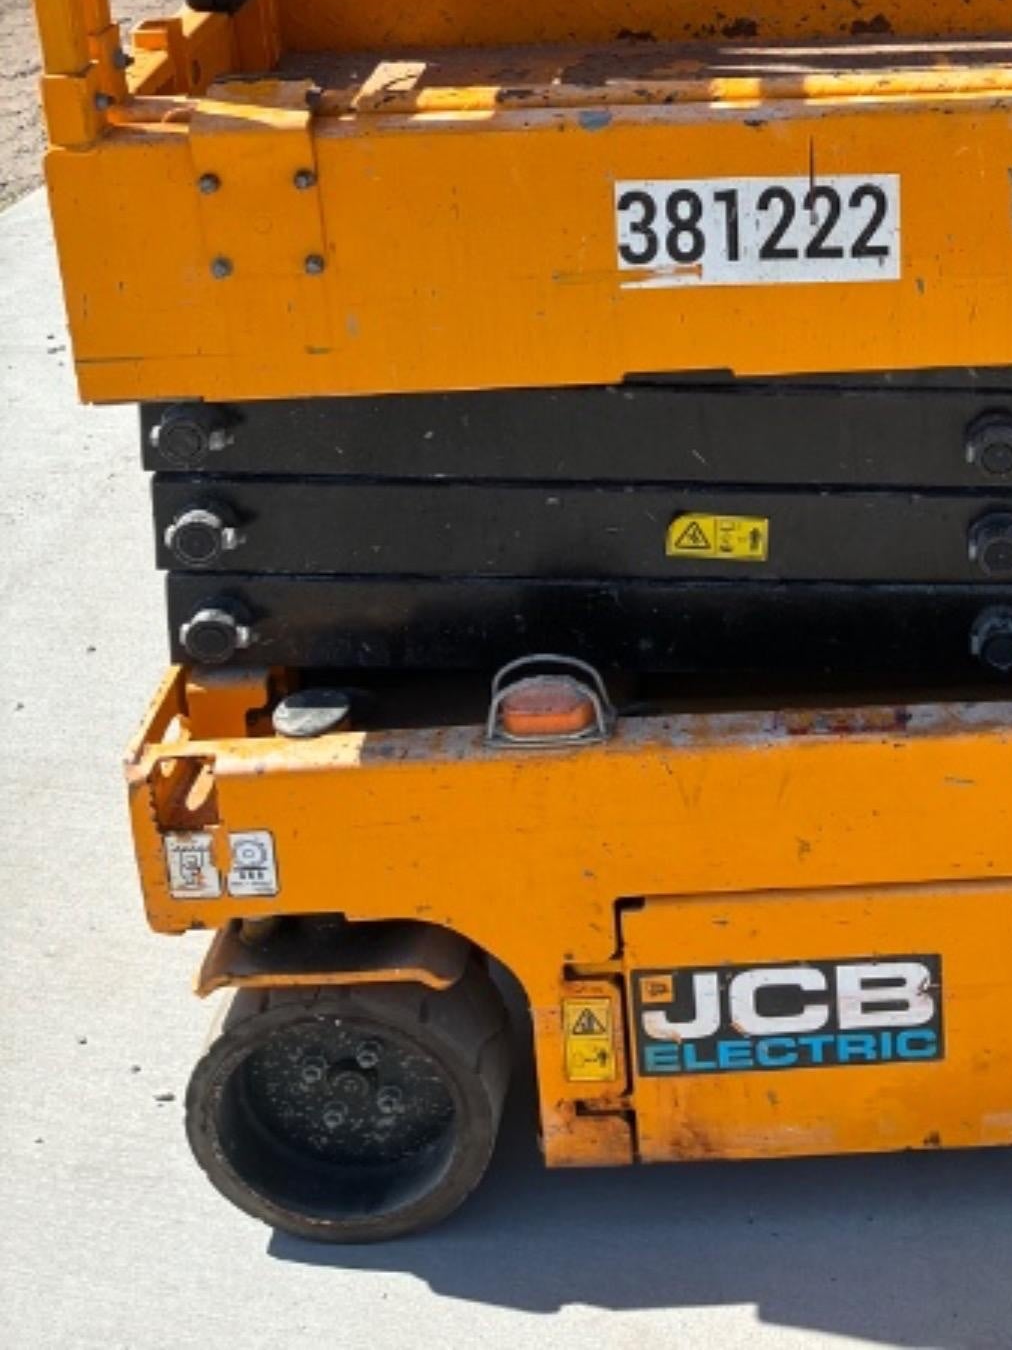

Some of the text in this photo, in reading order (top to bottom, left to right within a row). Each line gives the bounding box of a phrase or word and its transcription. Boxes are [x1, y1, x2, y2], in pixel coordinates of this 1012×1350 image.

[617, 183, 889, 264] 381222
[642, 962, 934, 1040] JCB
[645, 1028, 937, 1072] ELECTRIC
